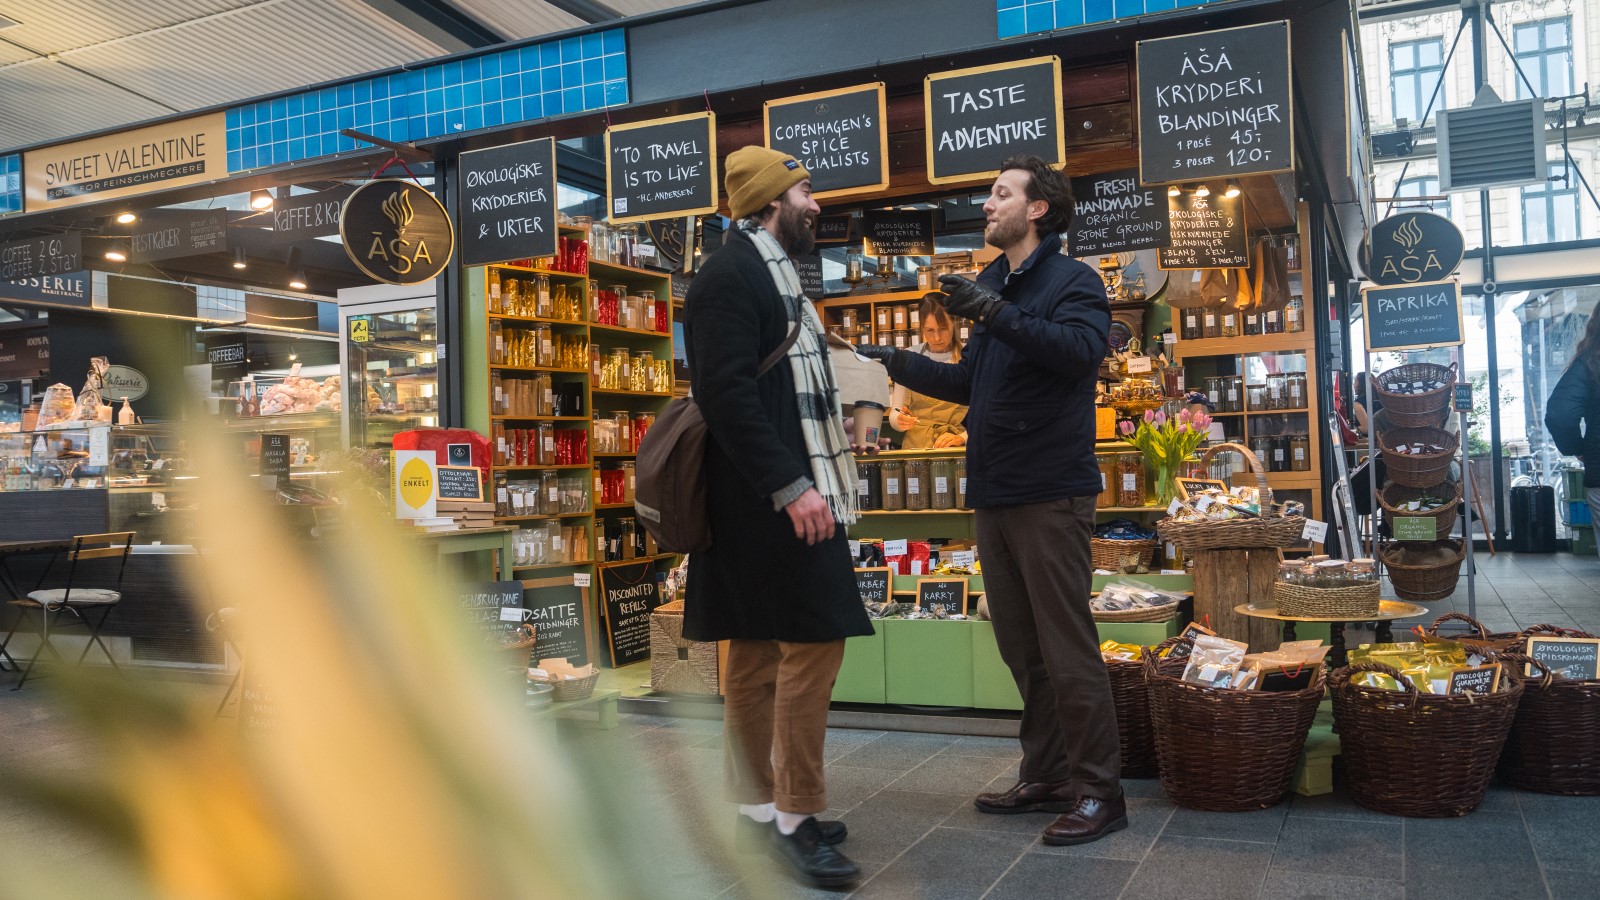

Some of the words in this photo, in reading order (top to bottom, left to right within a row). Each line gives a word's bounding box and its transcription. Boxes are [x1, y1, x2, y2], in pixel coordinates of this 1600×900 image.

[943, 83, 1026, 115] TASTE
[938, 117, 1047, 152] ADVENTURE
[647, 140, 702, 160] TRAVEL
[1176, 140, 1183, 151] 1
[45, 154, 101, 186] SWEET
[105, 133, 205, 173] VALENTINE
[1172, 160, 1182, 169] 3
[1186, 156, 1215, 168] POSER
[79, 183, 100, 192] FOR
[103, 163, 202, 188] FEINSCHMECKERE
[641, 170, 662, 184] TO
[654, 185, 696, 201] ANDERSEN
[1094, 177, 1136, 197] FRESH
[1073, 191, 1155, 216] HANDMADE
[315, 203, 324, 227] &
[1086, 209, 1140, 226] ORGANIC
[1226, 217, 1234, 228] &
[478, 223, 490, 240] &
[497, 216, 544, 238] URTER
[1076, 227, 1110, 242] STONE
[1116, 220, 1163, 240] GROUND
[1, 244, 32, 263] COFFEE
[39, 241, 46, 258] 2
[48, 239, 62, 256] GO
[1102, 240, 1126, 249] BLENDS
[1205, 248, 1226, 256] SELV
[2, 261, 33, 278] COFFEE
[39, 258, 46, 274] 2
[10, 275, 84, 292] SSERIE
[1377, 291, 1449, 313] PAPRIKA
[608, 583, 654, 603] DISCOUNTED
[924, 591, 955, 601] KARRY
[522, 603, 576, 622] DSATTE
[619, 600, 647, 616] REFILLS
[1534, 652, 1597, 661] SPIDSKOMMEN
[1536, 644, 1594, 653] ØKOLOGISK
